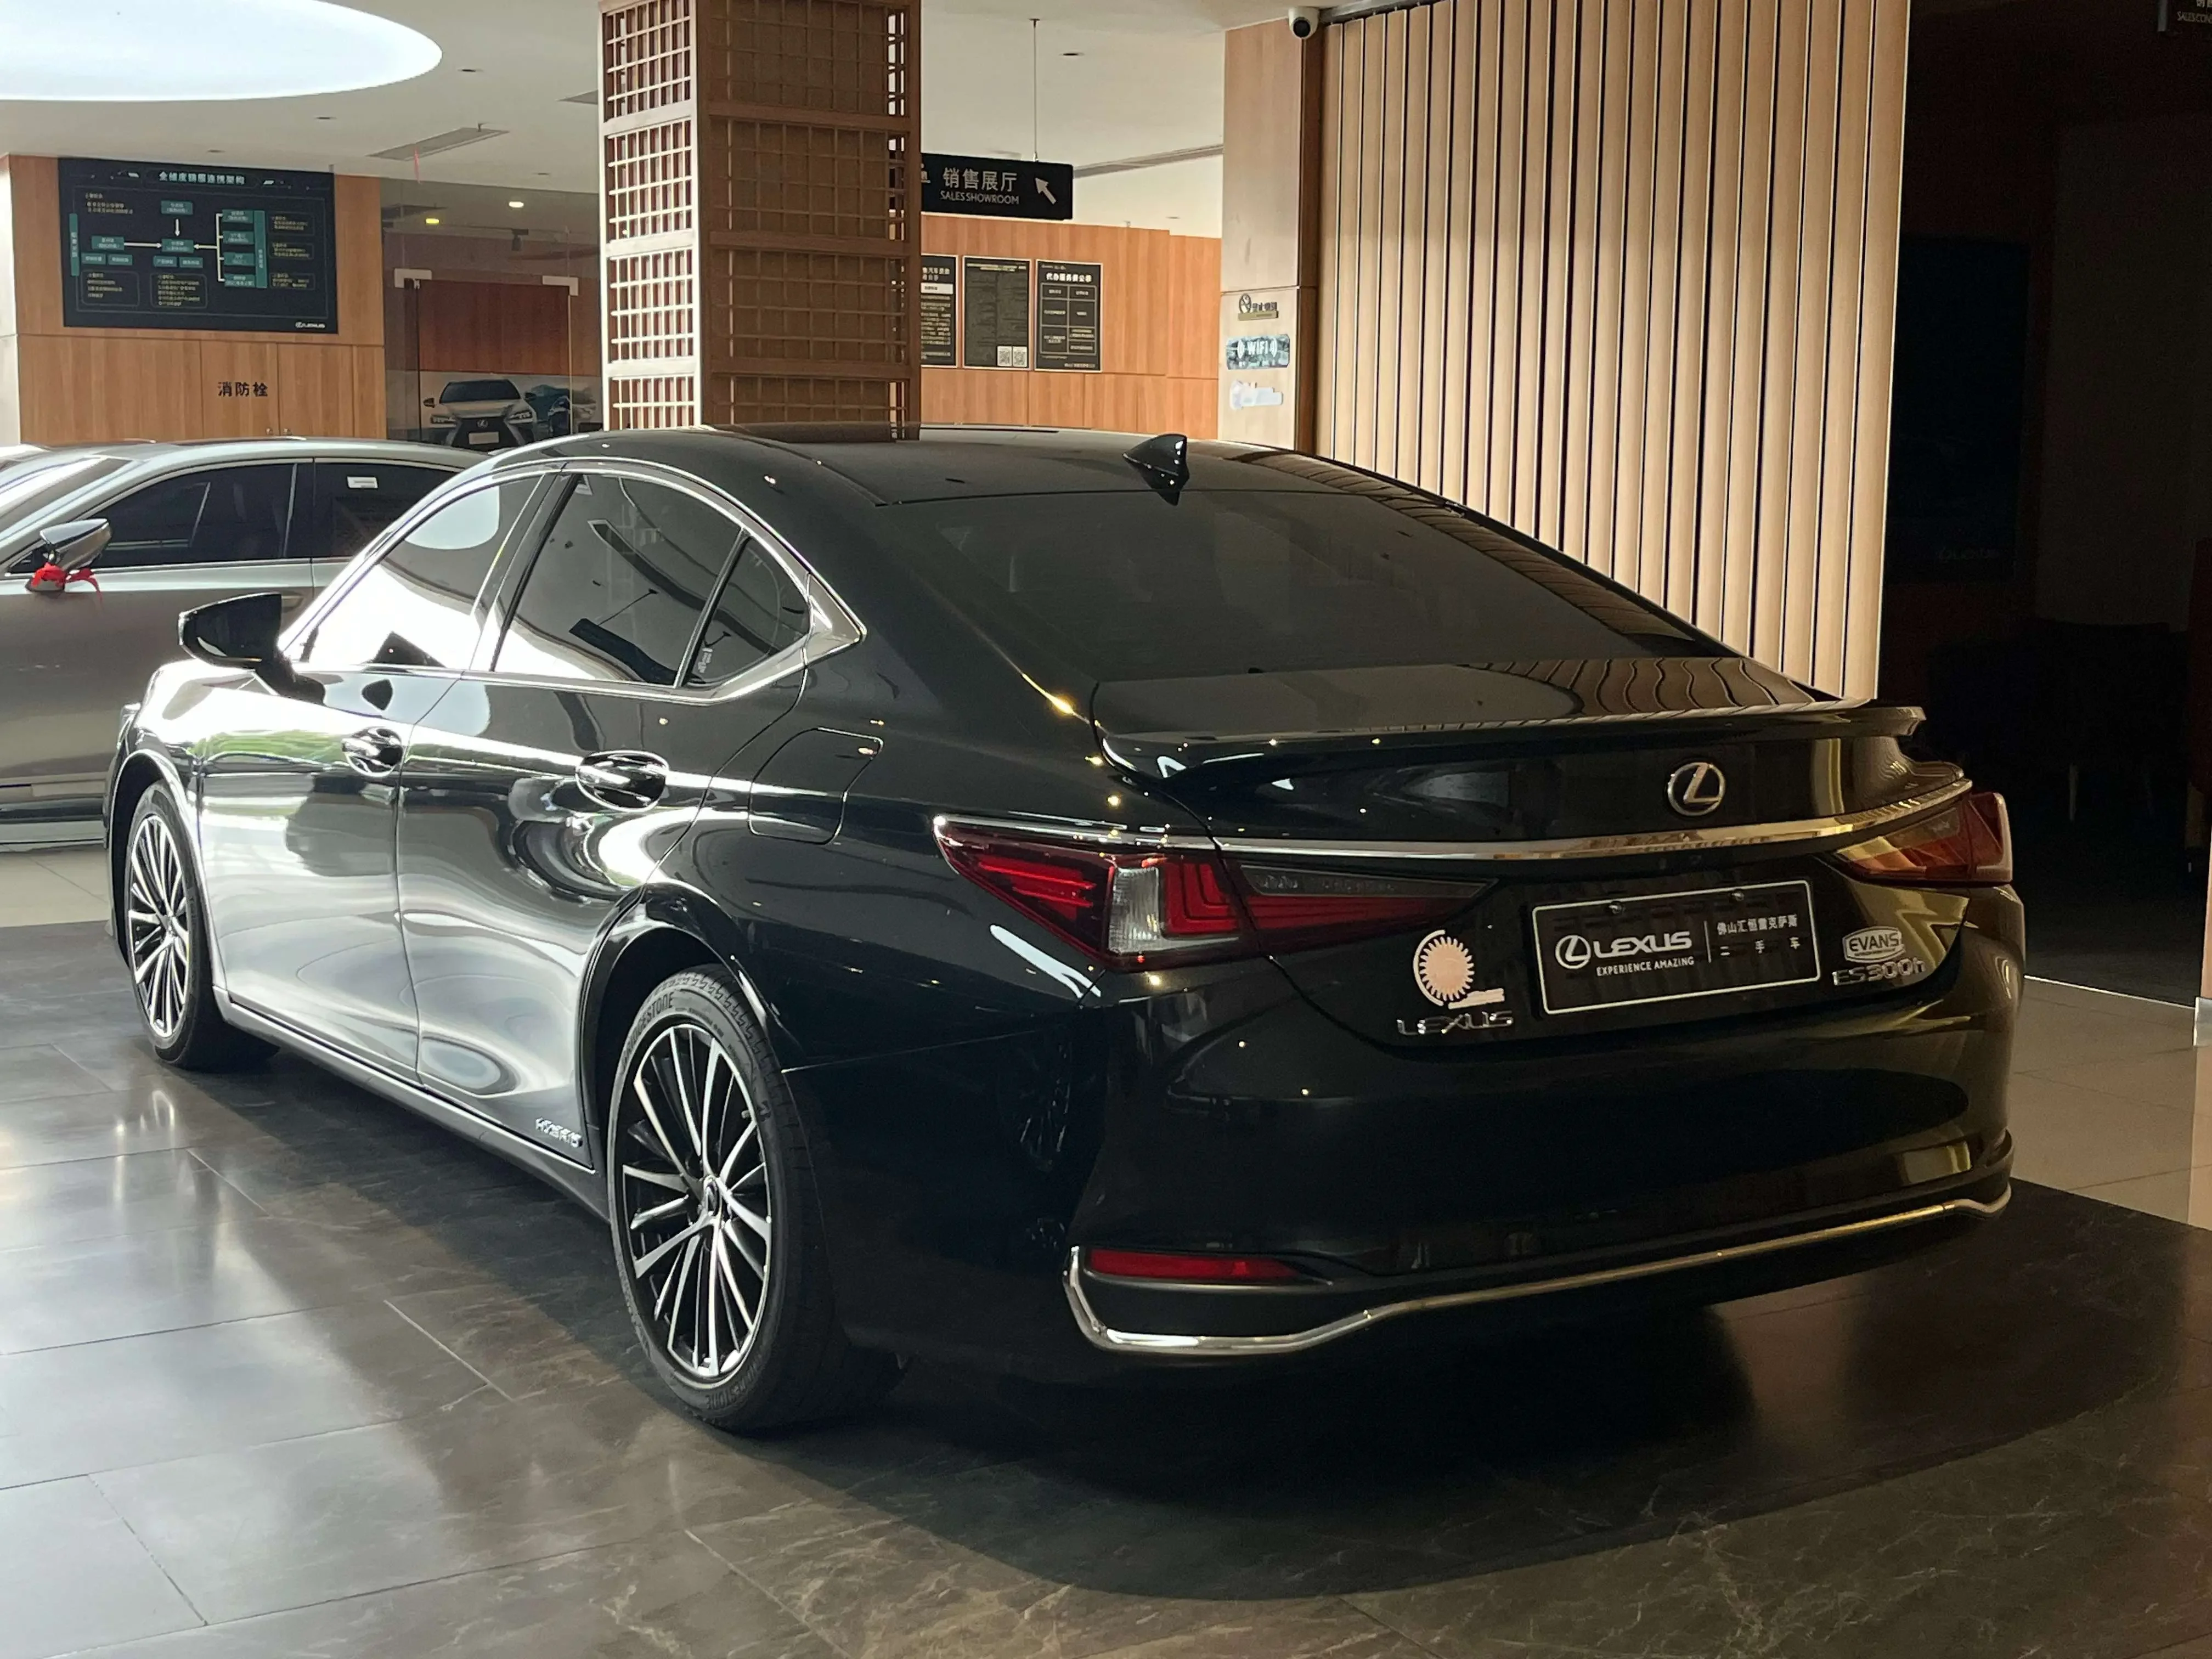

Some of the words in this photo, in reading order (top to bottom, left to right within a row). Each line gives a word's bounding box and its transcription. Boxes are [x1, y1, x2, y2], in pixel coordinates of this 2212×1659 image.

[943, 167, 1017, 192] 销售展厅
[940, 190, 966, 201] SALES
[966, 192, 1019, 205] SHOWROOM
[1247, 341, 1268, 356] WIFI
[217, 381, 268, 397] 消防栓
[1593, 930, 1691, 958] LEXUS
[1849, 933, 1899, 952] EVANS
[1596, 961, 1652, 977] EXPERIENCE
[1654, 956, 1695, 971] AMAZING
[1832, 957, 1926, 986] ES300h
[1397, 1011, 1514, 1035] LEXUS
